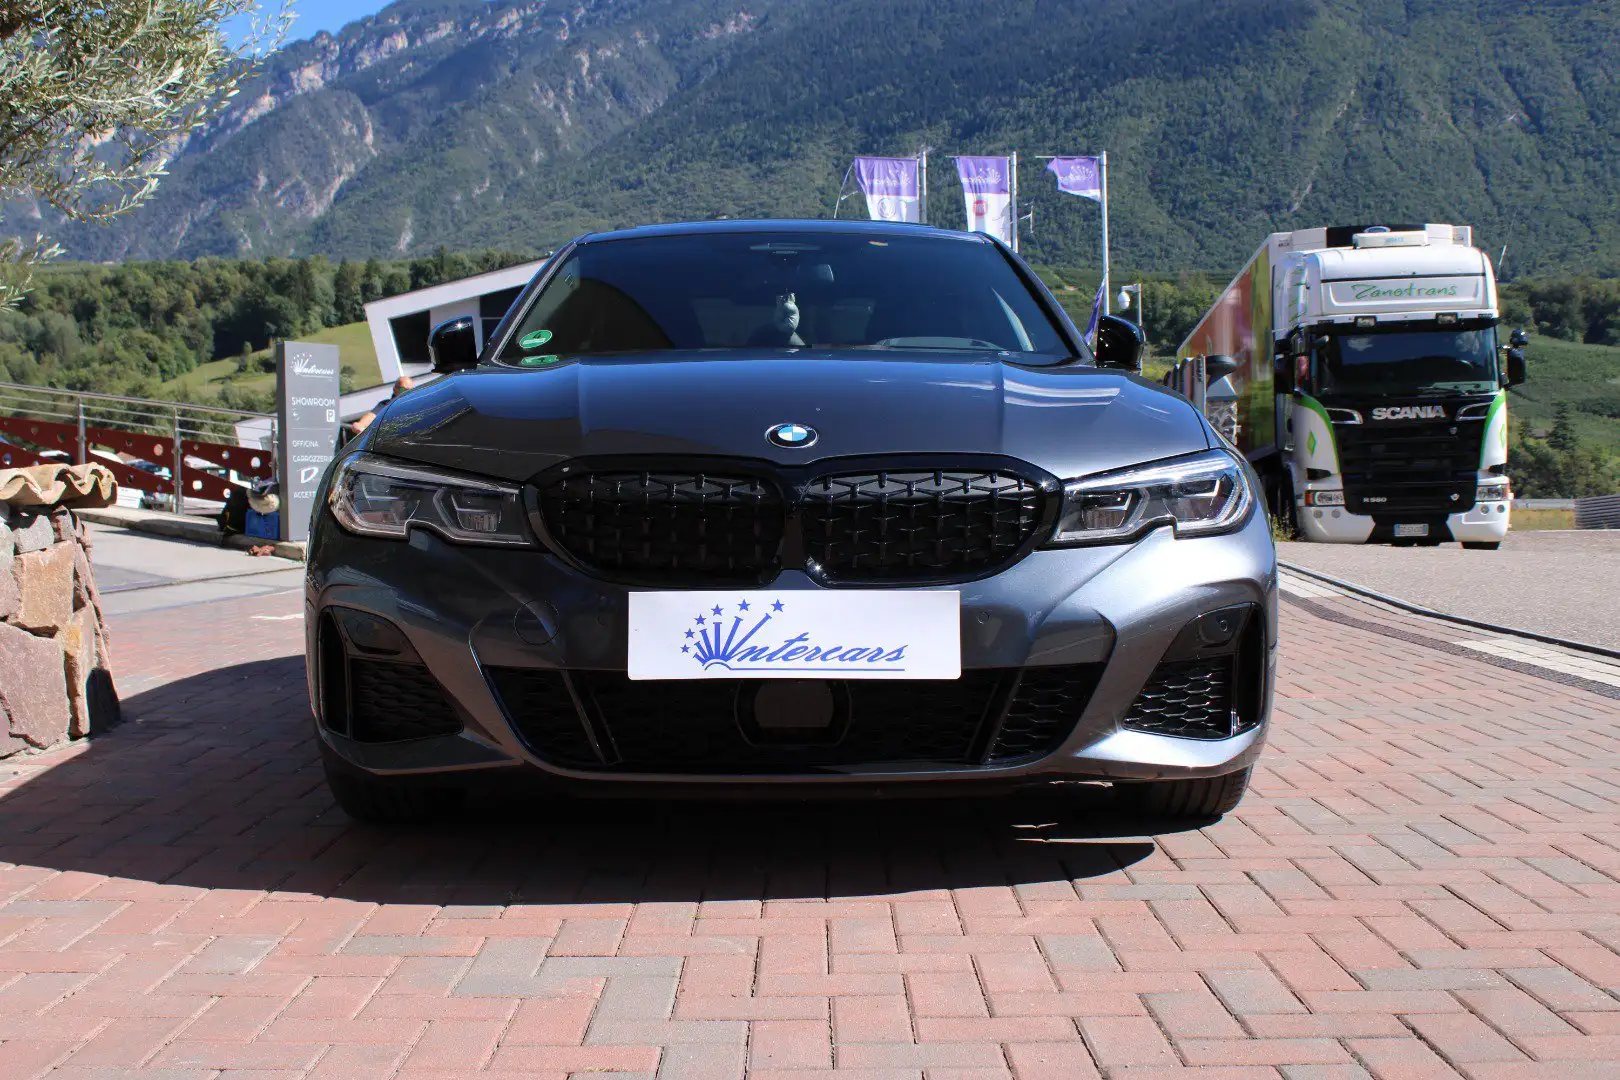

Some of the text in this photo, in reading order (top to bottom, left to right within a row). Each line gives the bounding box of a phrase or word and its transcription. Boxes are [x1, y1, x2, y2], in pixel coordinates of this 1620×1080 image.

[1351, 283, 1458, 300] Zanotrans
[292, 396, 336, 407] SHOWROOM
[1371, 405, 1446, 420] SCANIA
[693, 612, 909, 665] Intercars
